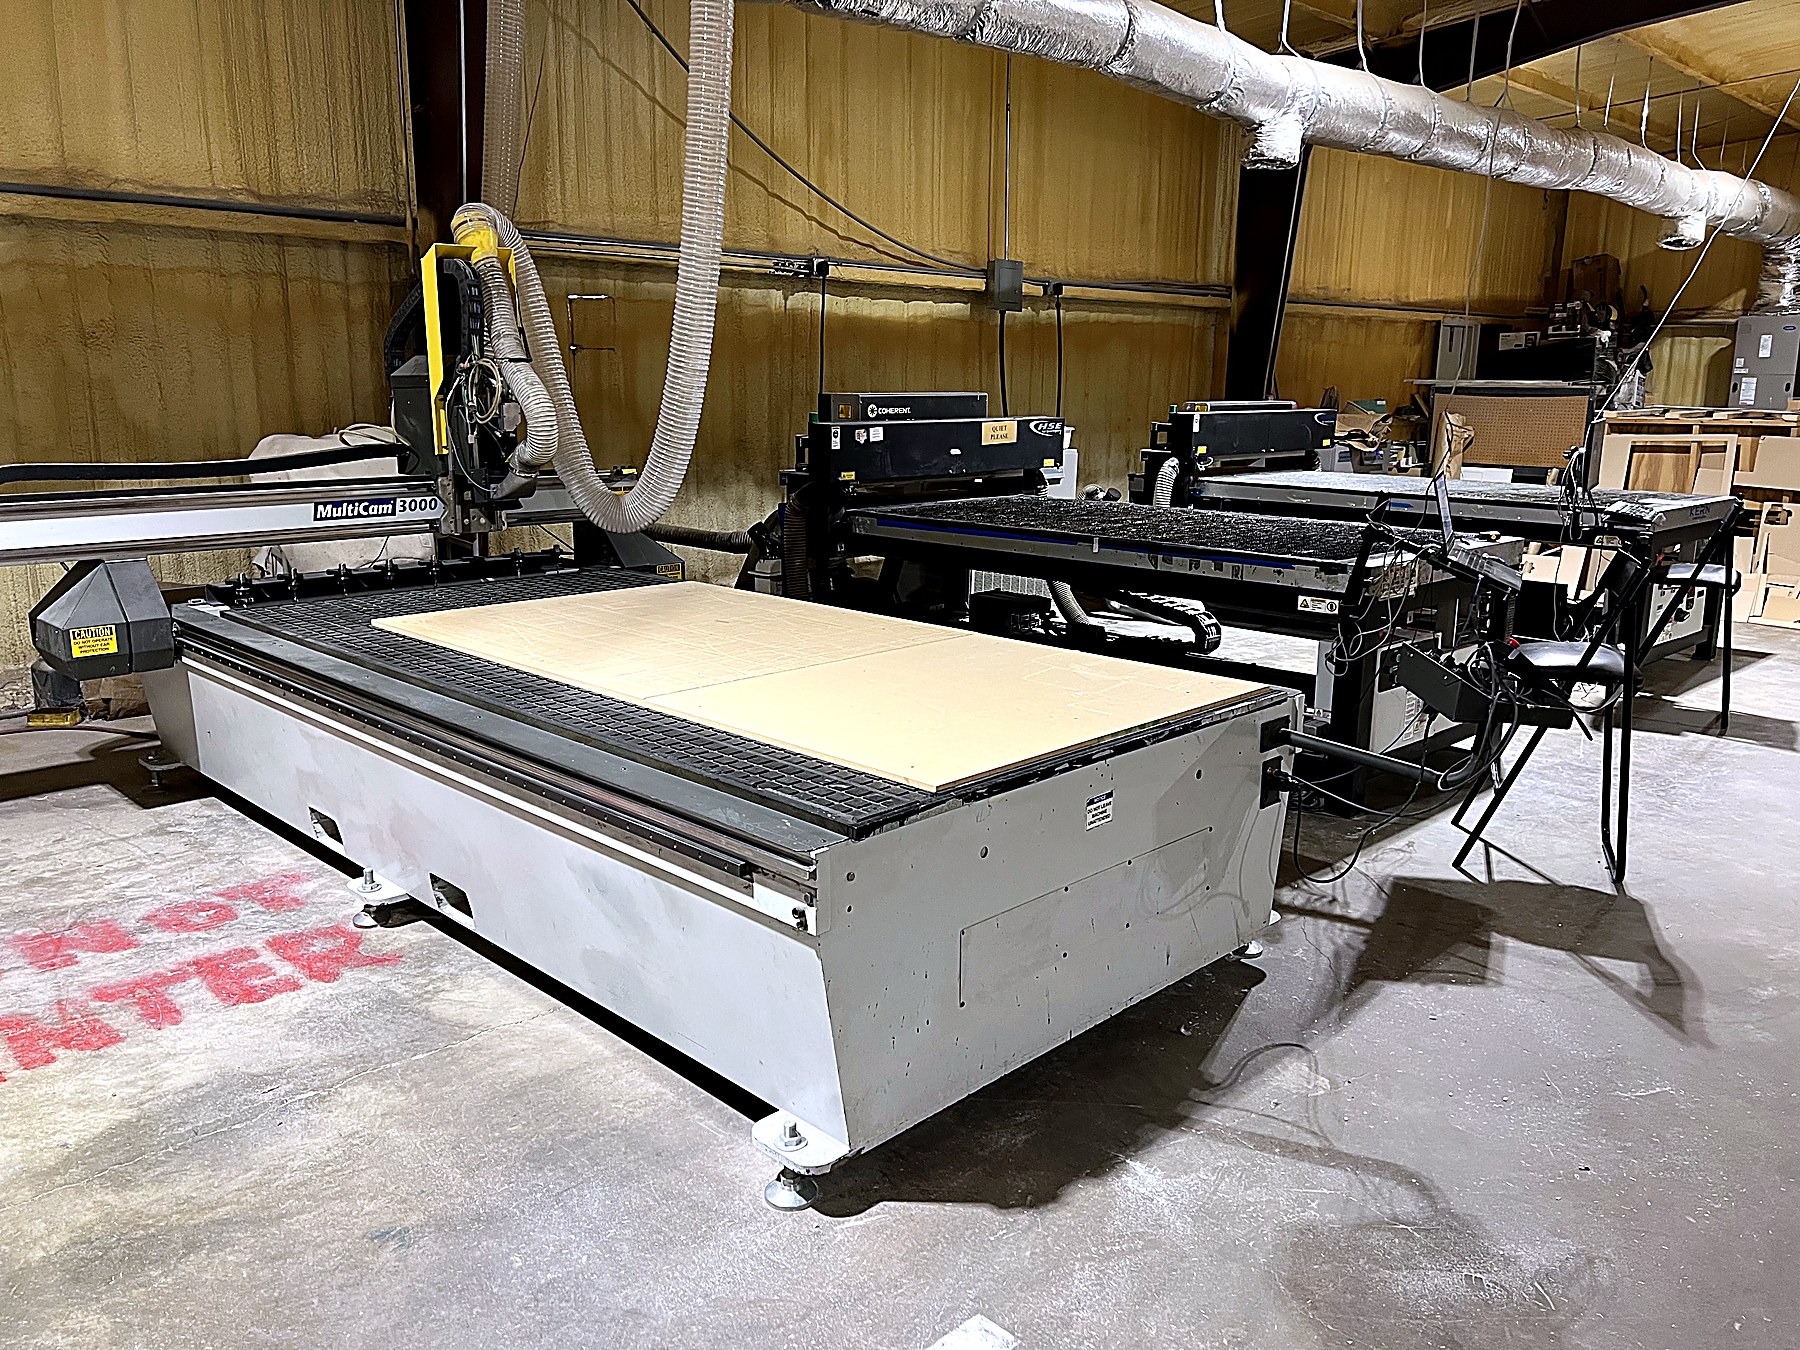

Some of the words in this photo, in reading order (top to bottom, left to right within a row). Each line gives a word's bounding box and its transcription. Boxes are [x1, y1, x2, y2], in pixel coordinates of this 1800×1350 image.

[878, 407, 911, 415] COHERENT
[991, 425, 1007, 433] QUIET
[1037, 422, 1063, 430] HSE
[316, 501, 393, 519] MultiCam
[398, 497, 438, 513] 3000
[1690, 505, 1711, 517] KERN
[74, 627, 112, 640] CAUTION
[10, 871, 312, 971] NOT
[0, 921, 402, 1082] NTER
